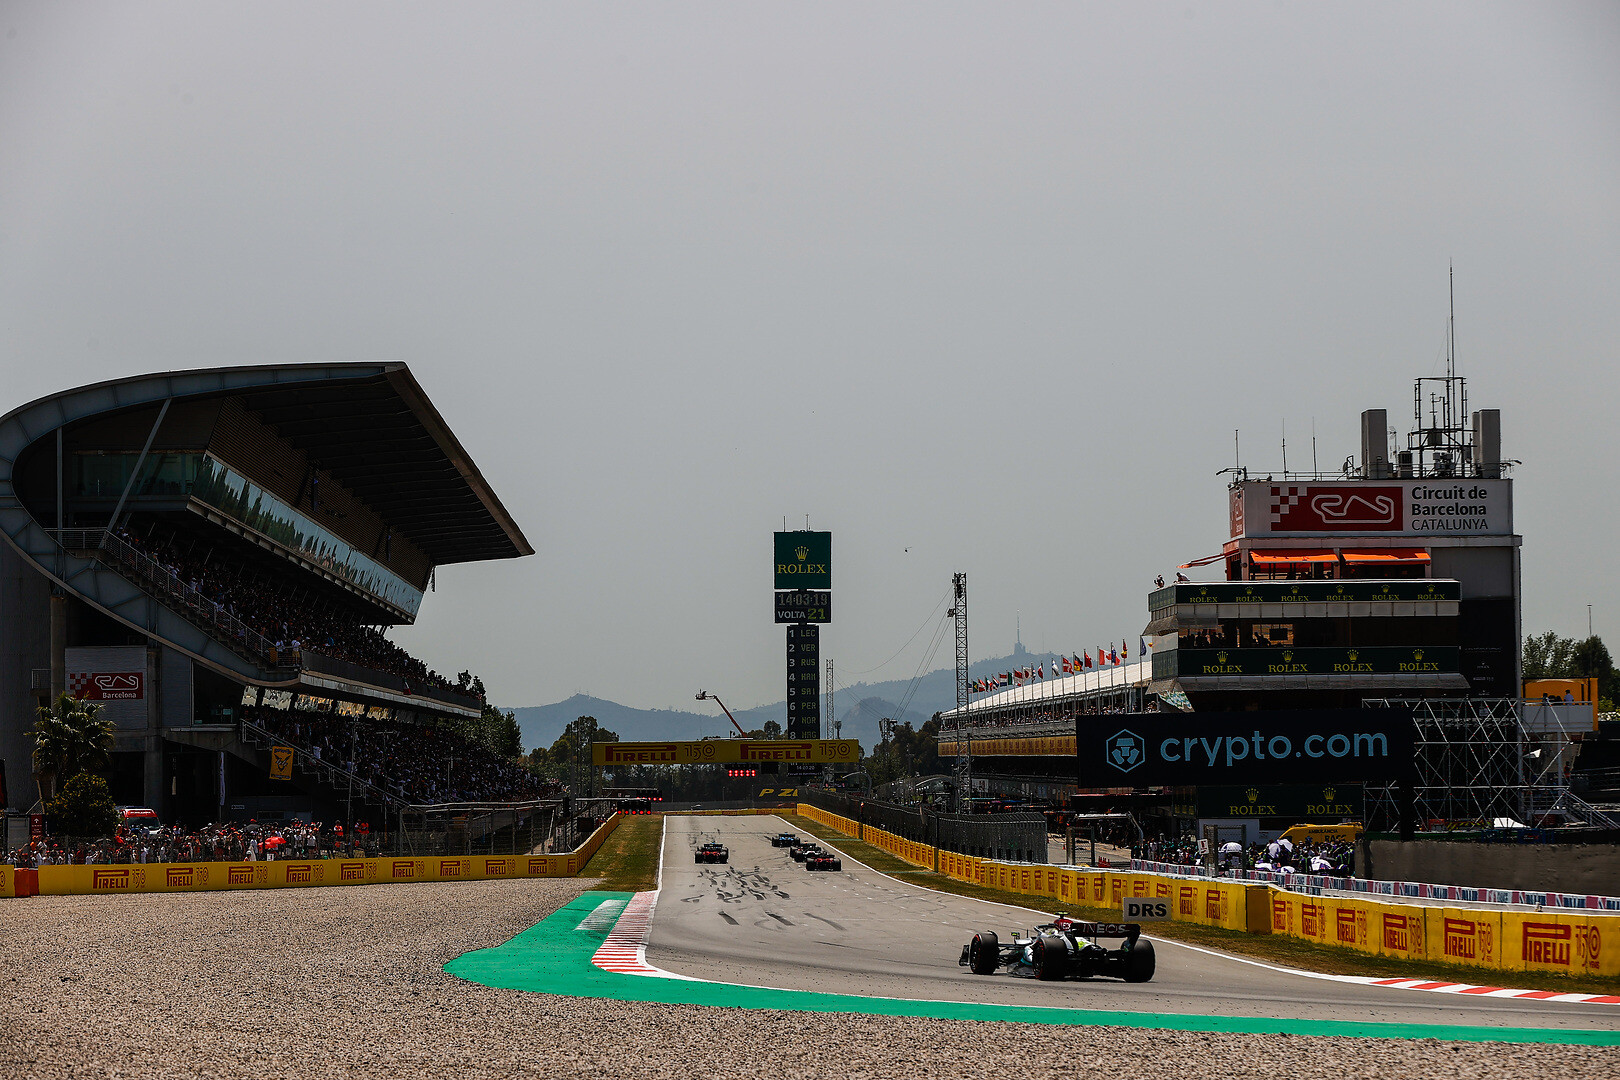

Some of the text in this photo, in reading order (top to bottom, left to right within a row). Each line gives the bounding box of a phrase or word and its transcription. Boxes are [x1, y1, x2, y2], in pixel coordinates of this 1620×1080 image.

[1411, 486, 1487, 500] Circuit de
[1411, 503, 1487, 516] Barcelona
[1411, 519, 1488, 531] CATALUNYA
[777, 563, 826, 574] ROLEX
[778, 593, 828, 606] 14:03:19
[778, 608, 826, 620] VOLTA 21
[789, 630, 795, 638] 1
[789, 644, 795, 652] 2
[789, 659, 795, 667] 3
[1203, 664, 1243, 673] ROLEX
[1268, 664, 1309, 673] ROLEX
[1333, 663, 1375, 672] ROLEX
[1398, 662, 1440, 672] ROLEX
[789, 673, 796, 681] 4
[789, 688, 795, 696] 5
[789, 702, 796, 710] 6
[789, 717, 796, 725] 7
[789, 731, 796, 740] 8
[605, 744, 716, 762] PIRELLI 150
[740, 742, 851, 760] PIRELLI 150
[1160, 730, 1388, 767] crypto.com
[758, 788, 775, 797] P
[1229, 805, 1277, 816] ROLEX
[1306, 804, 1354, 815] ROLEX
[341, 862, 364, 880] PIRELLI
[392, 861, 414, 878] PIRELLI
[440, 860, 460, 876] PIRELLI
[485, 859, 506, 875] PIRELLI
[528, 858, 547, 874] PIRELLI
[93, 869, 130, 889] PIRELLI
[166, 867, 193, 887] PIRELLI
[228, 866, 254, 884] PIRELLI
[286, 865, 311, 883] PIRELLI
[1128, 903, 1167, 917] DRS
[1083, 924, 1127, 934] INEOS
[1336, 908, 1355, 943] PIRELLI
[1383, 912, 1408, 952] PIRELLI
[1444, 917, 1475, 959] PIRELLI
[1522, 921, 1601, 967] PIRELLI 150
